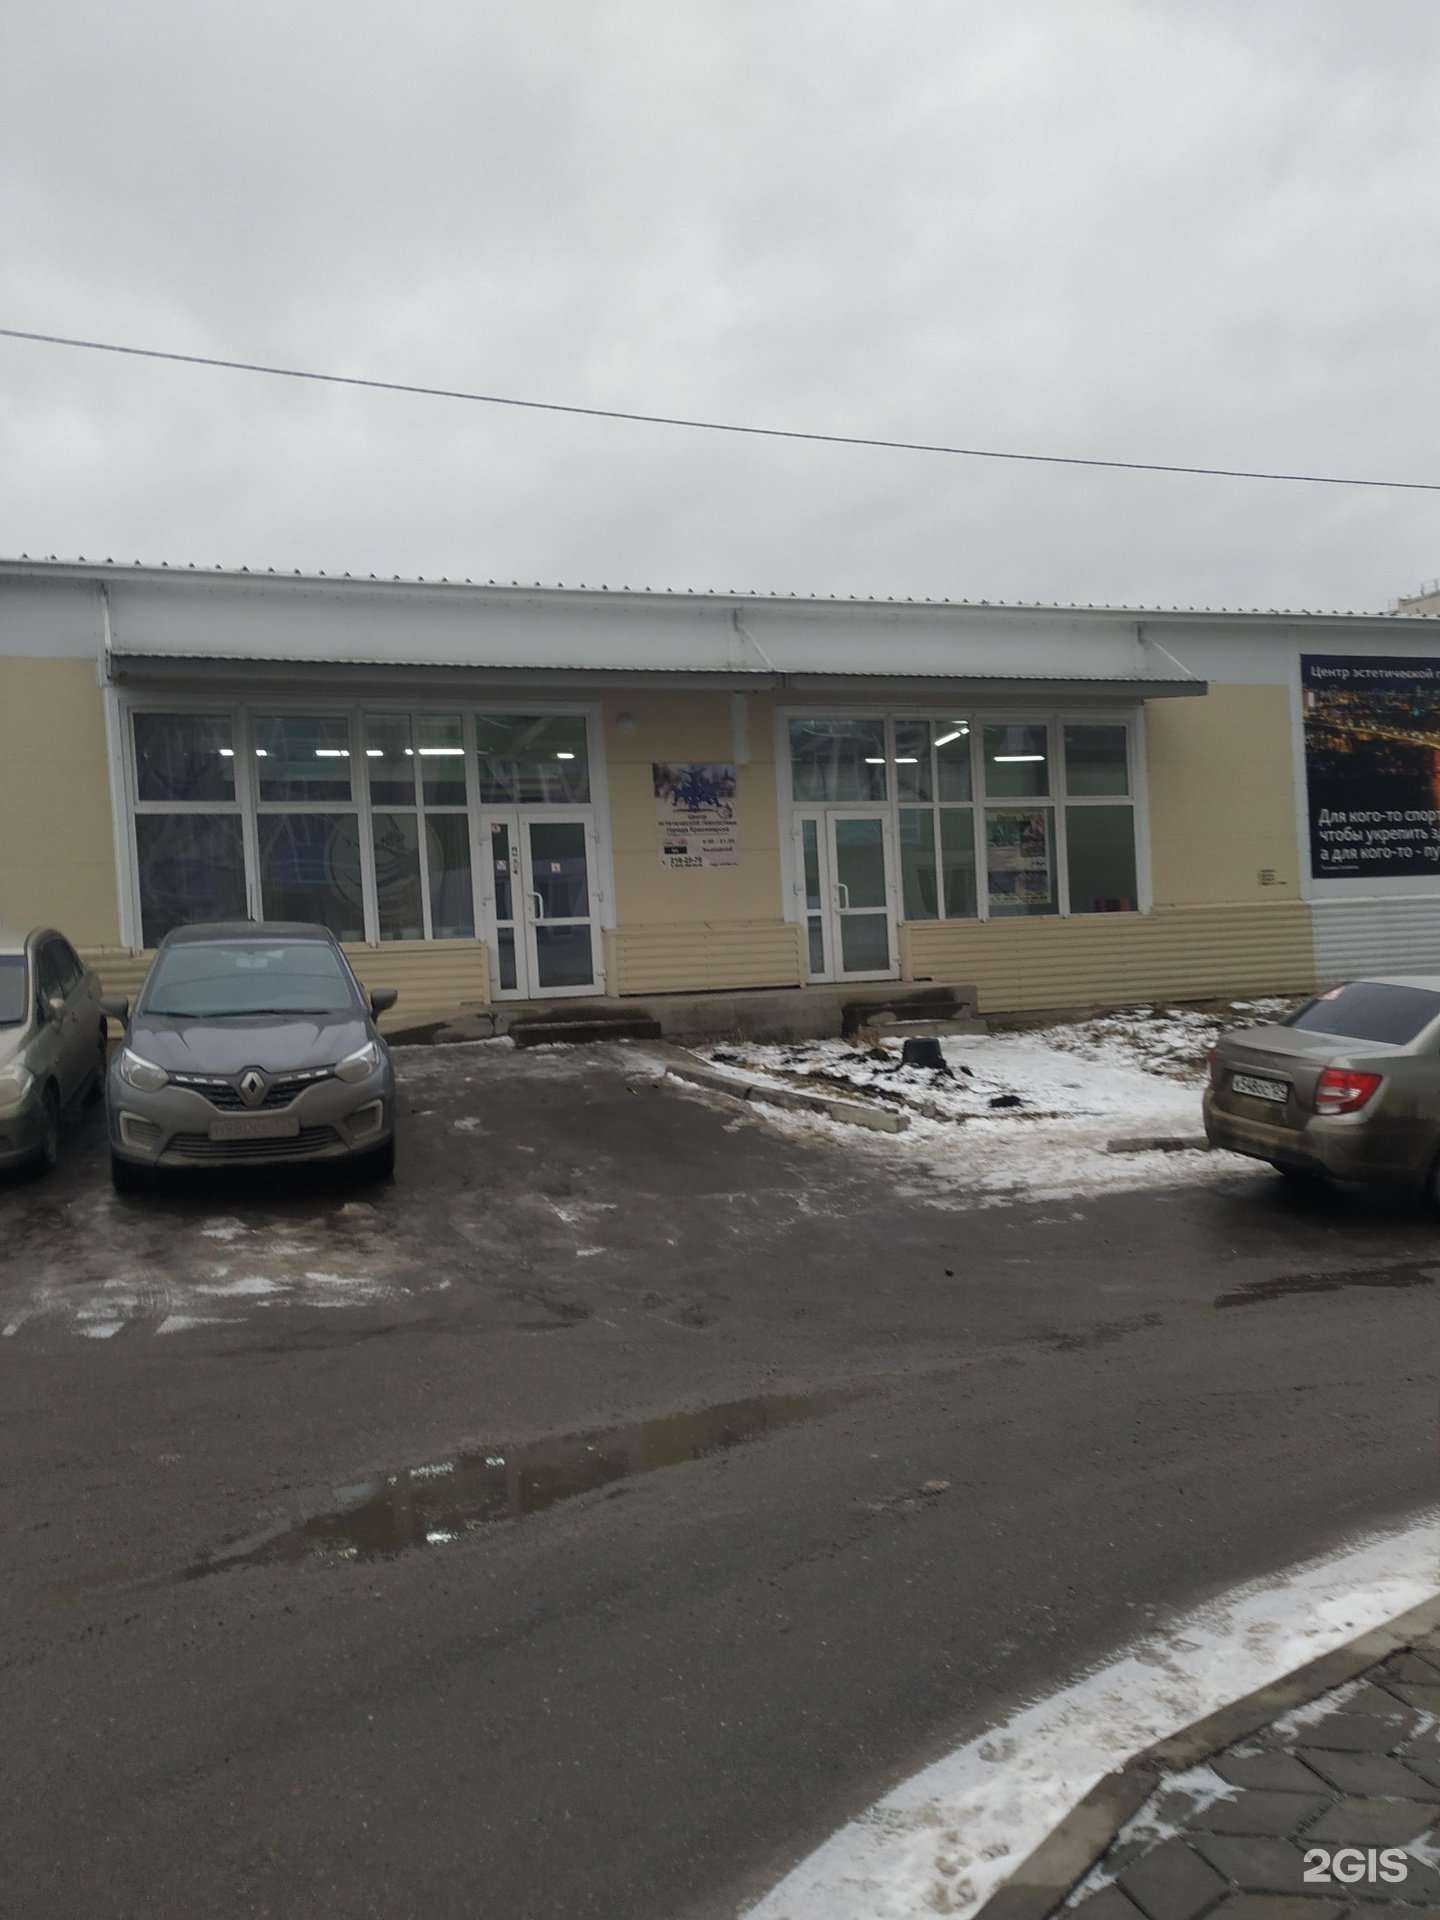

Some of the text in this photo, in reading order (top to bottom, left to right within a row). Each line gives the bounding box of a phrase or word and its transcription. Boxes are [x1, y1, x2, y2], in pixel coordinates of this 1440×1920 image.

[1312, 665, 1349, 681] Центр
[1352, 666, 1433, 679] эстетической
[1318, 808, 1347, 826] Для
[1349, 810, 1402, 823] кого-то
[1319, 826, 1363, 841] чтобы
[1365, 829, 1429, 845] укрепить
[1319, 848, 1330, 861] а
[1331, 848, 1358, 863] для
[1360, 846, 1414, 860] кого-то
